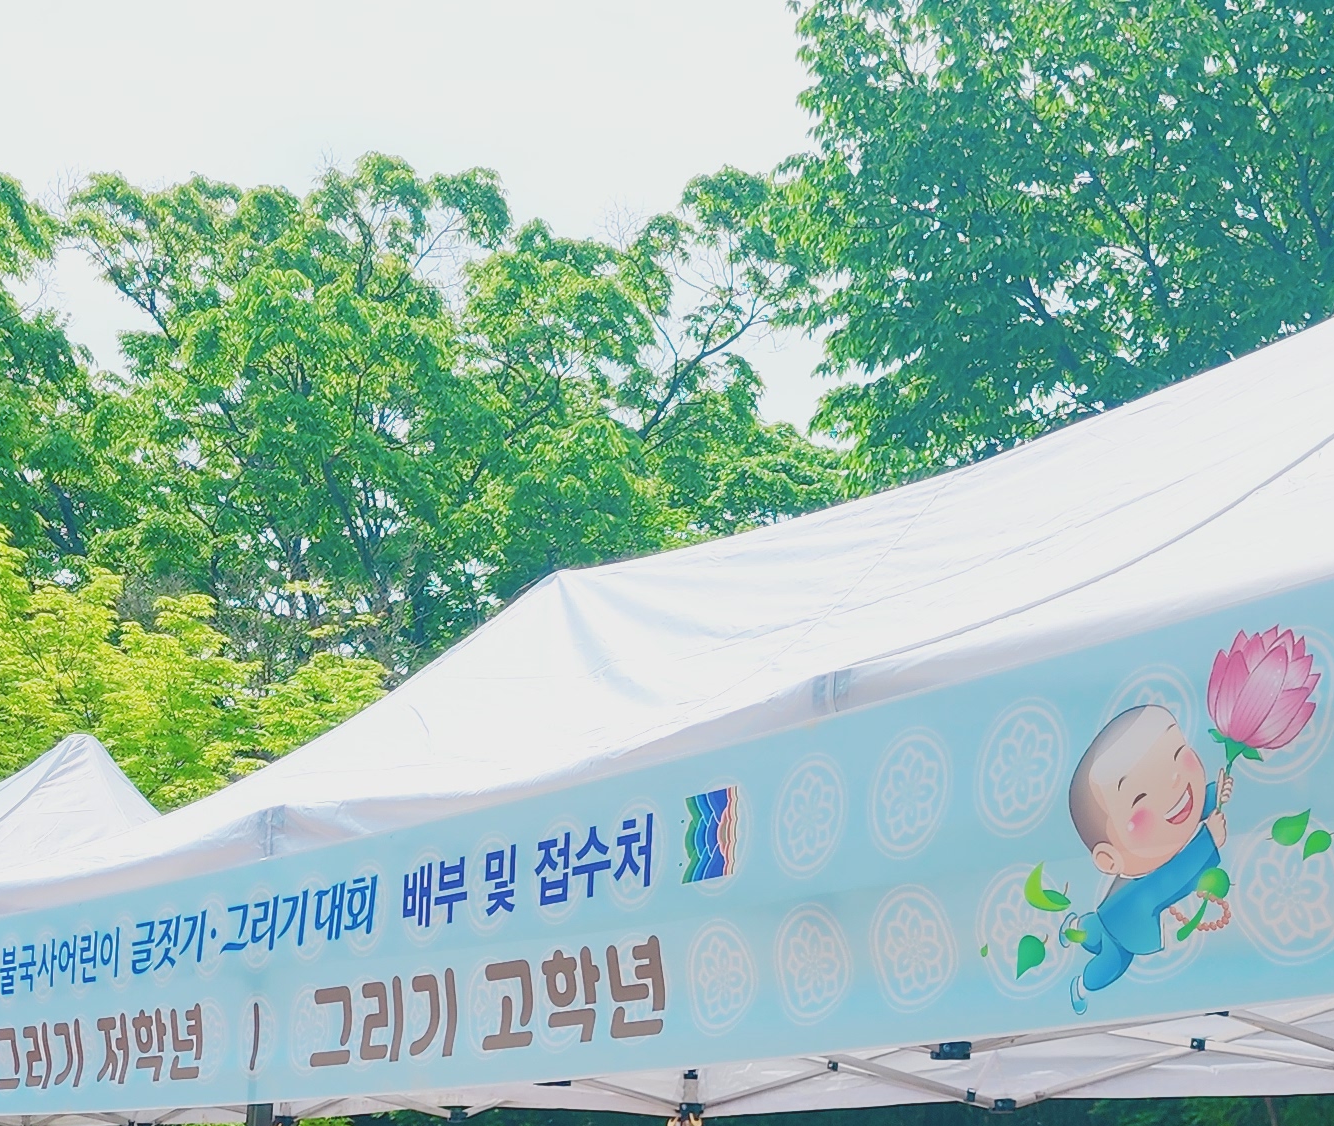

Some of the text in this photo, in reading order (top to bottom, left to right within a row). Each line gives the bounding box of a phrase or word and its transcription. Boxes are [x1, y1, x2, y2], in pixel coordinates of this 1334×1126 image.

[0, 926, 120, 996] 불국사어린이
[403, 856, 468, 928] 배부
[484, 844, 517, 916] 및
[534, 813, 654, 907] 접수처
[97, 1003, 203, 1084] 저학년
[310, 967, 458, 1068] 그리기
[482, 935, 665, 1051] 고학년
